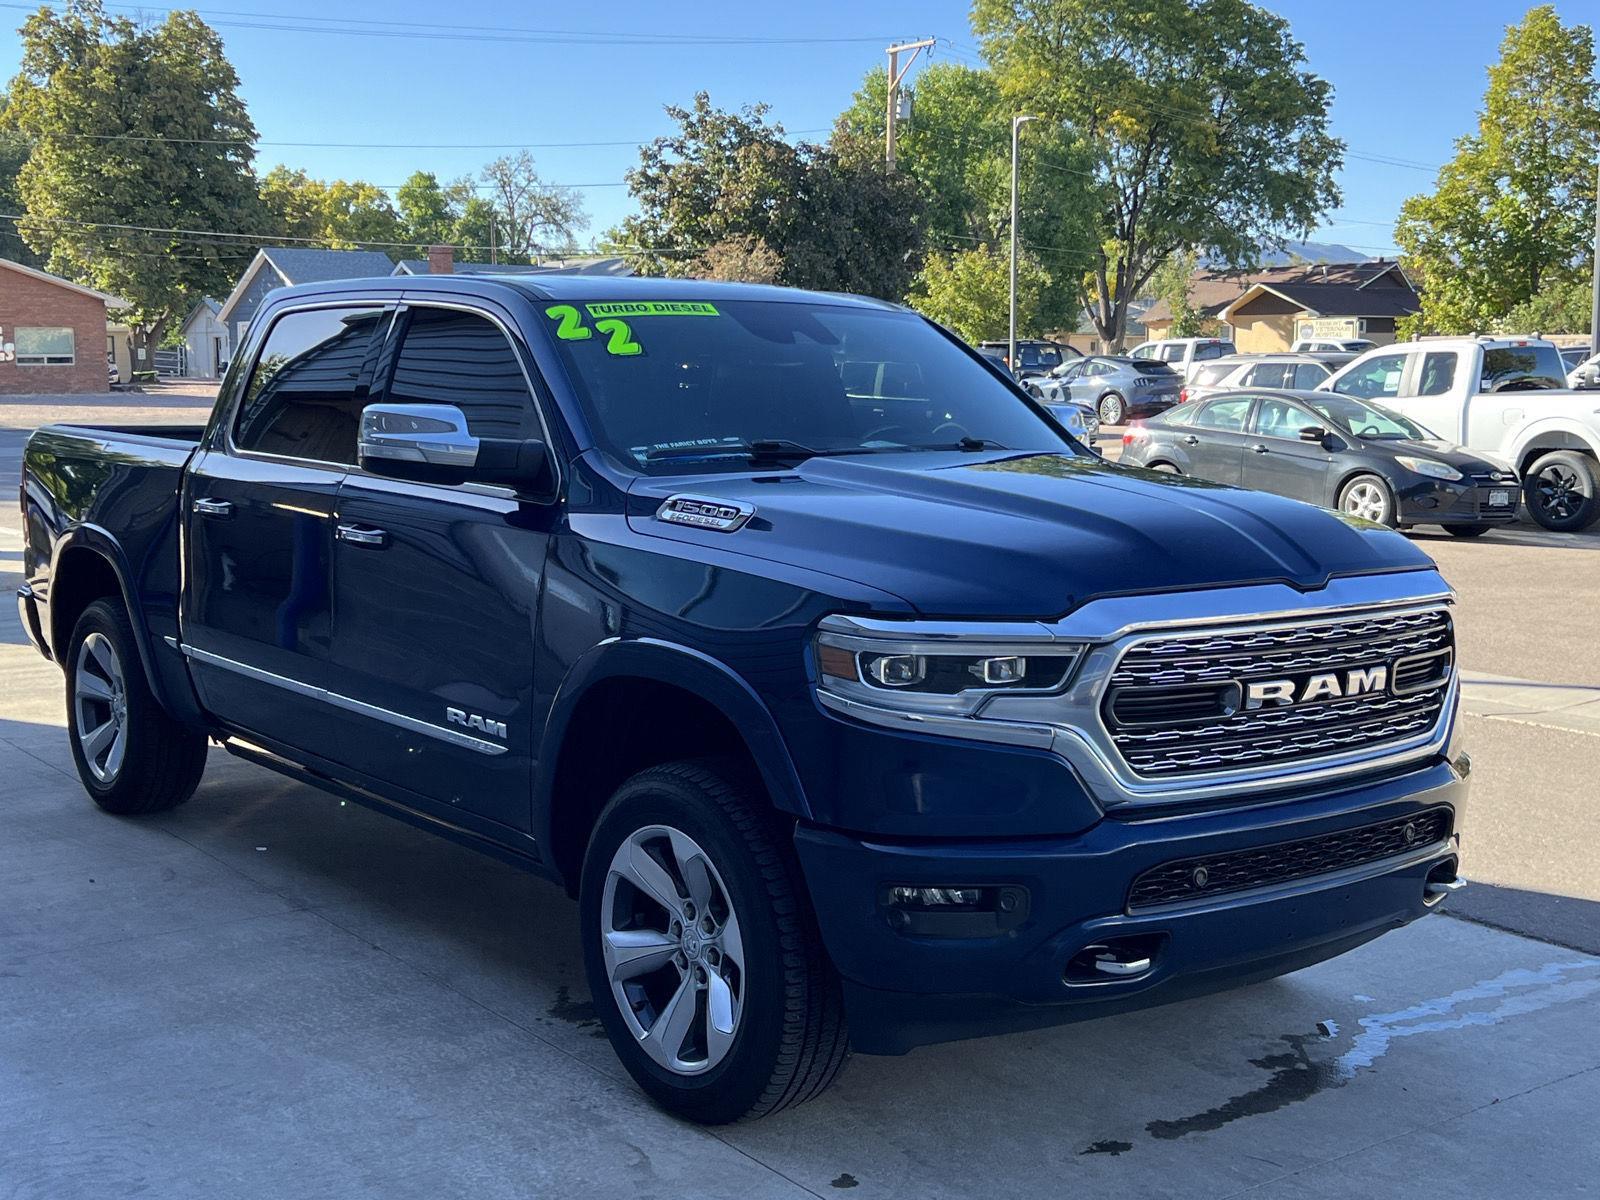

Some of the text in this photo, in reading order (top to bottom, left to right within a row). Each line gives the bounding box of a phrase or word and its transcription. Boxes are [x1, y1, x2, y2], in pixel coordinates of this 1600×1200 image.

[588, 303, 713, 314] TURBO DIESEL
[670, 511, 726, 527] ECODIESEL
[674, 500, 737, 519] 1500
[1245, 665, 1387, 710] RAM
[446, 706, 507, 739] RAM
